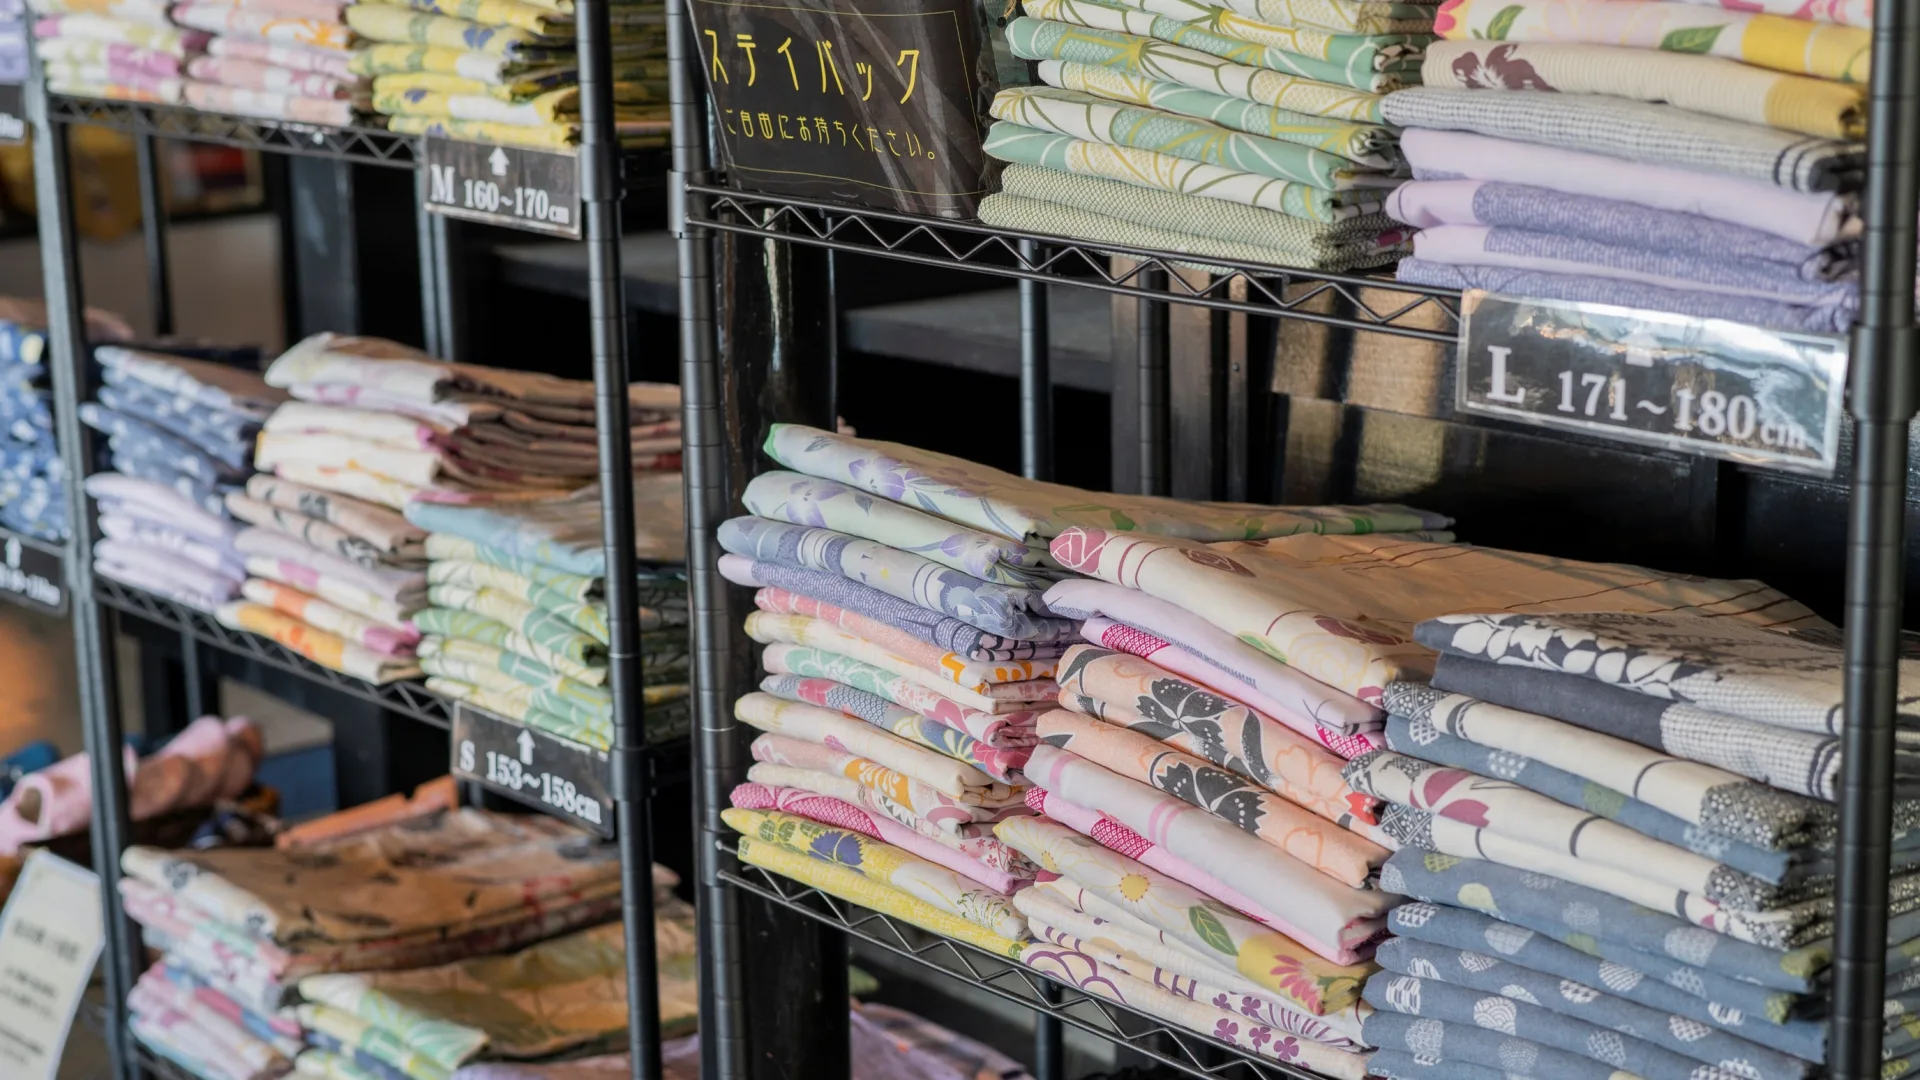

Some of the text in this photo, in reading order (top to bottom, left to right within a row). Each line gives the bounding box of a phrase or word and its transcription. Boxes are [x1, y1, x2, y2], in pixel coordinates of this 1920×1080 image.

[726, 109, 935, 160] ご自由にお持ちください。
[430, 163, 456, 204] M
[1486, 345, 1526, 404] L
[460, 739, 475, 772] S
